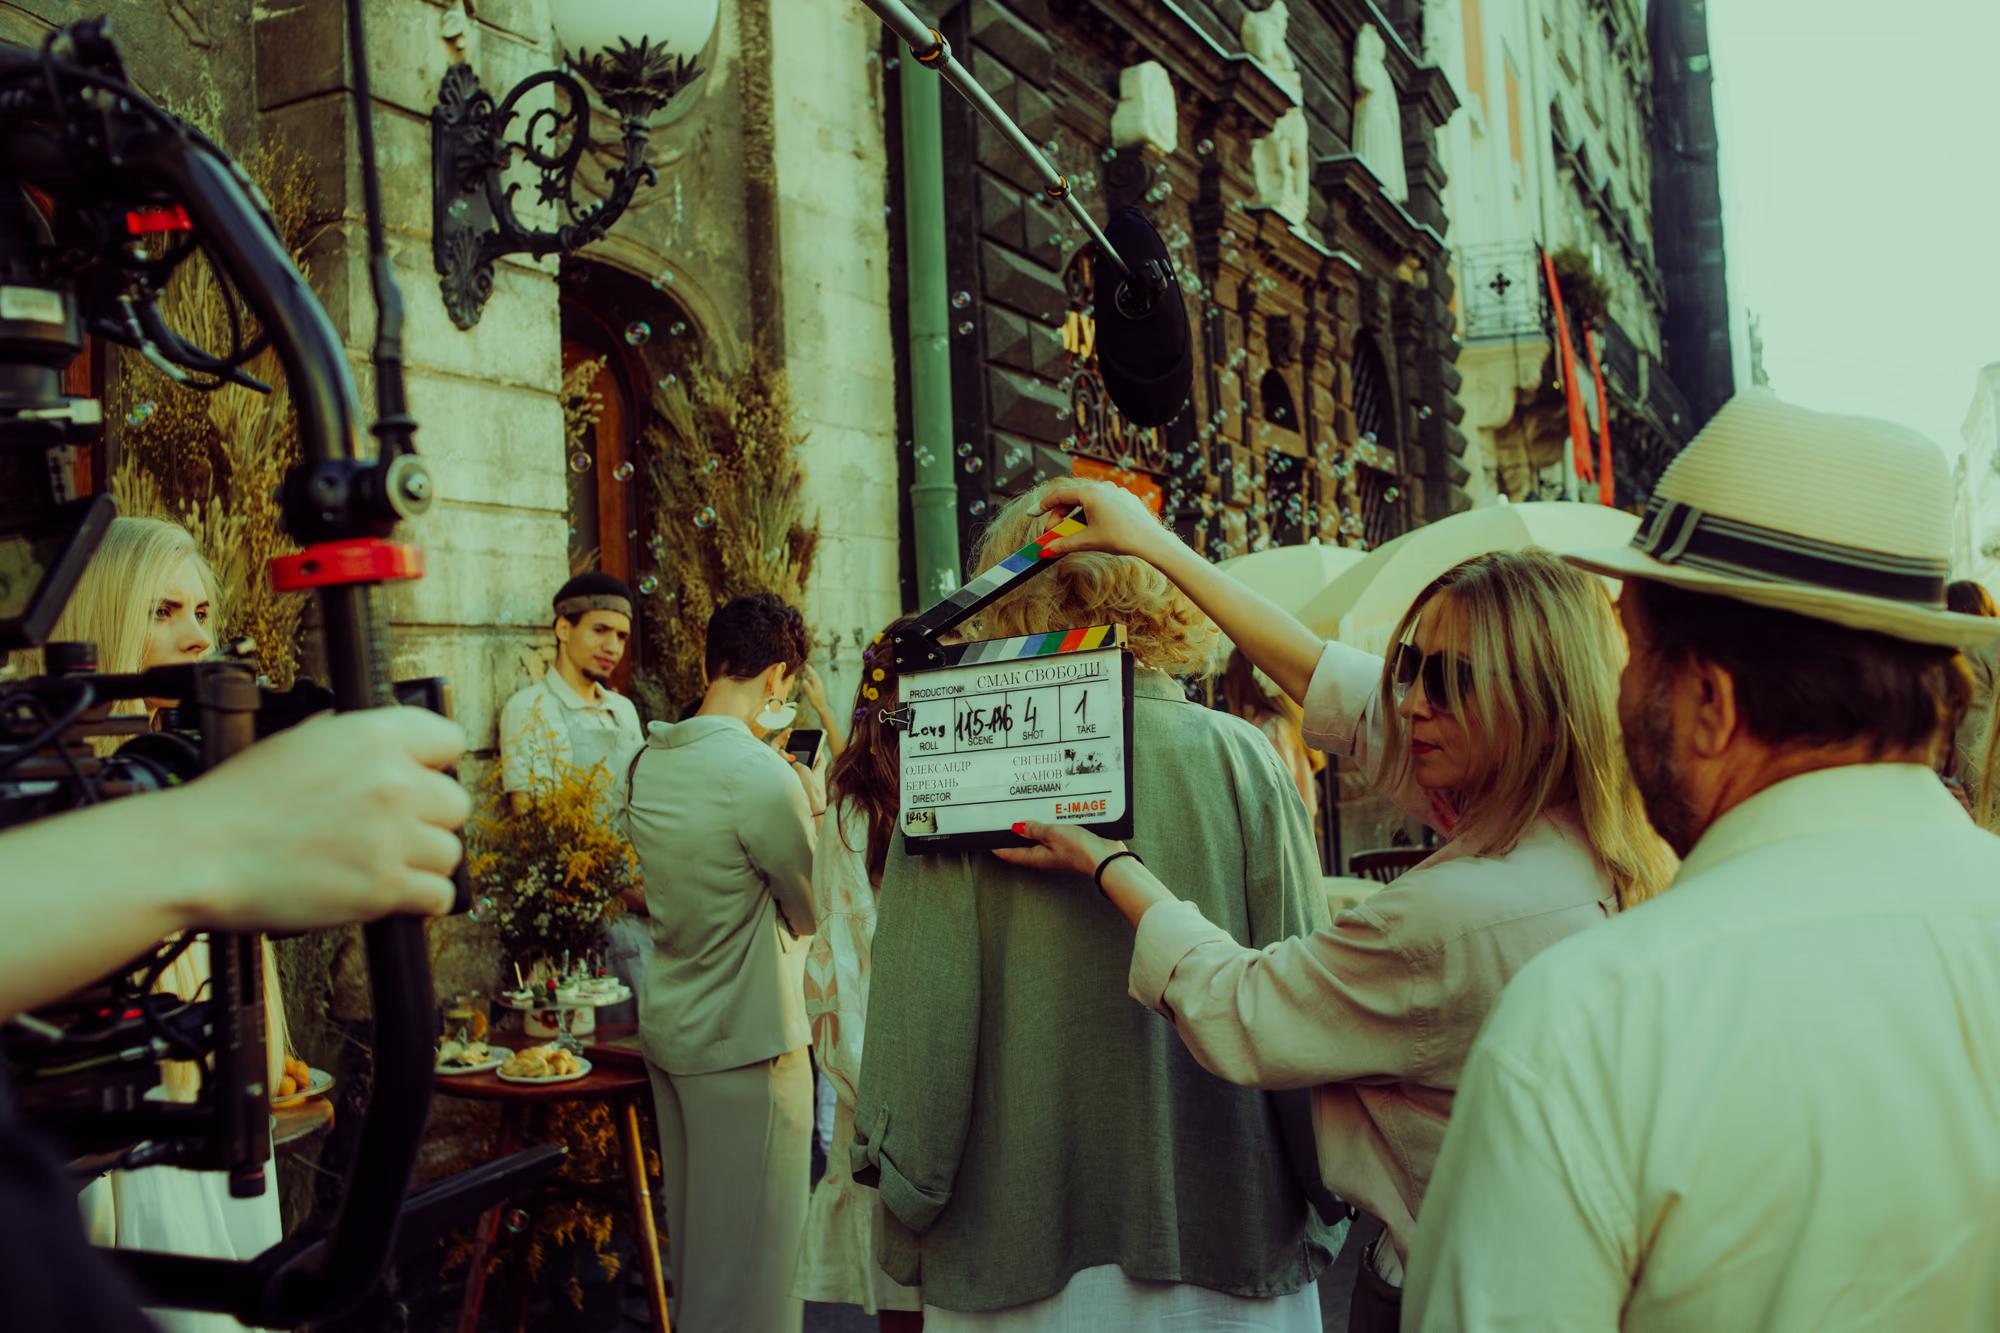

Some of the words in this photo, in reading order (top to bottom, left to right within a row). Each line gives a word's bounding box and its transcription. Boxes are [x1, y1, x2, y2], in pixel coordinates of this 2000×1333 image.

[977, 671, 1020, 689] СМАК
[1074, 690, 1088, 724] 1
[1024, 696, 1037, 732] 4
[1076, 724, 1097, 734] TAKE
[967, 735, 994, 746] SCENE
[1022, 730, 1044, 741] SHOT
[919, 741, 939, 751] ROLL
[1009, 783, 1062, 796] CAMERAMAN
[912, 792, 951, 804] DIRECTOR
[1055, 799, 1106, 814] E-IMAGE
